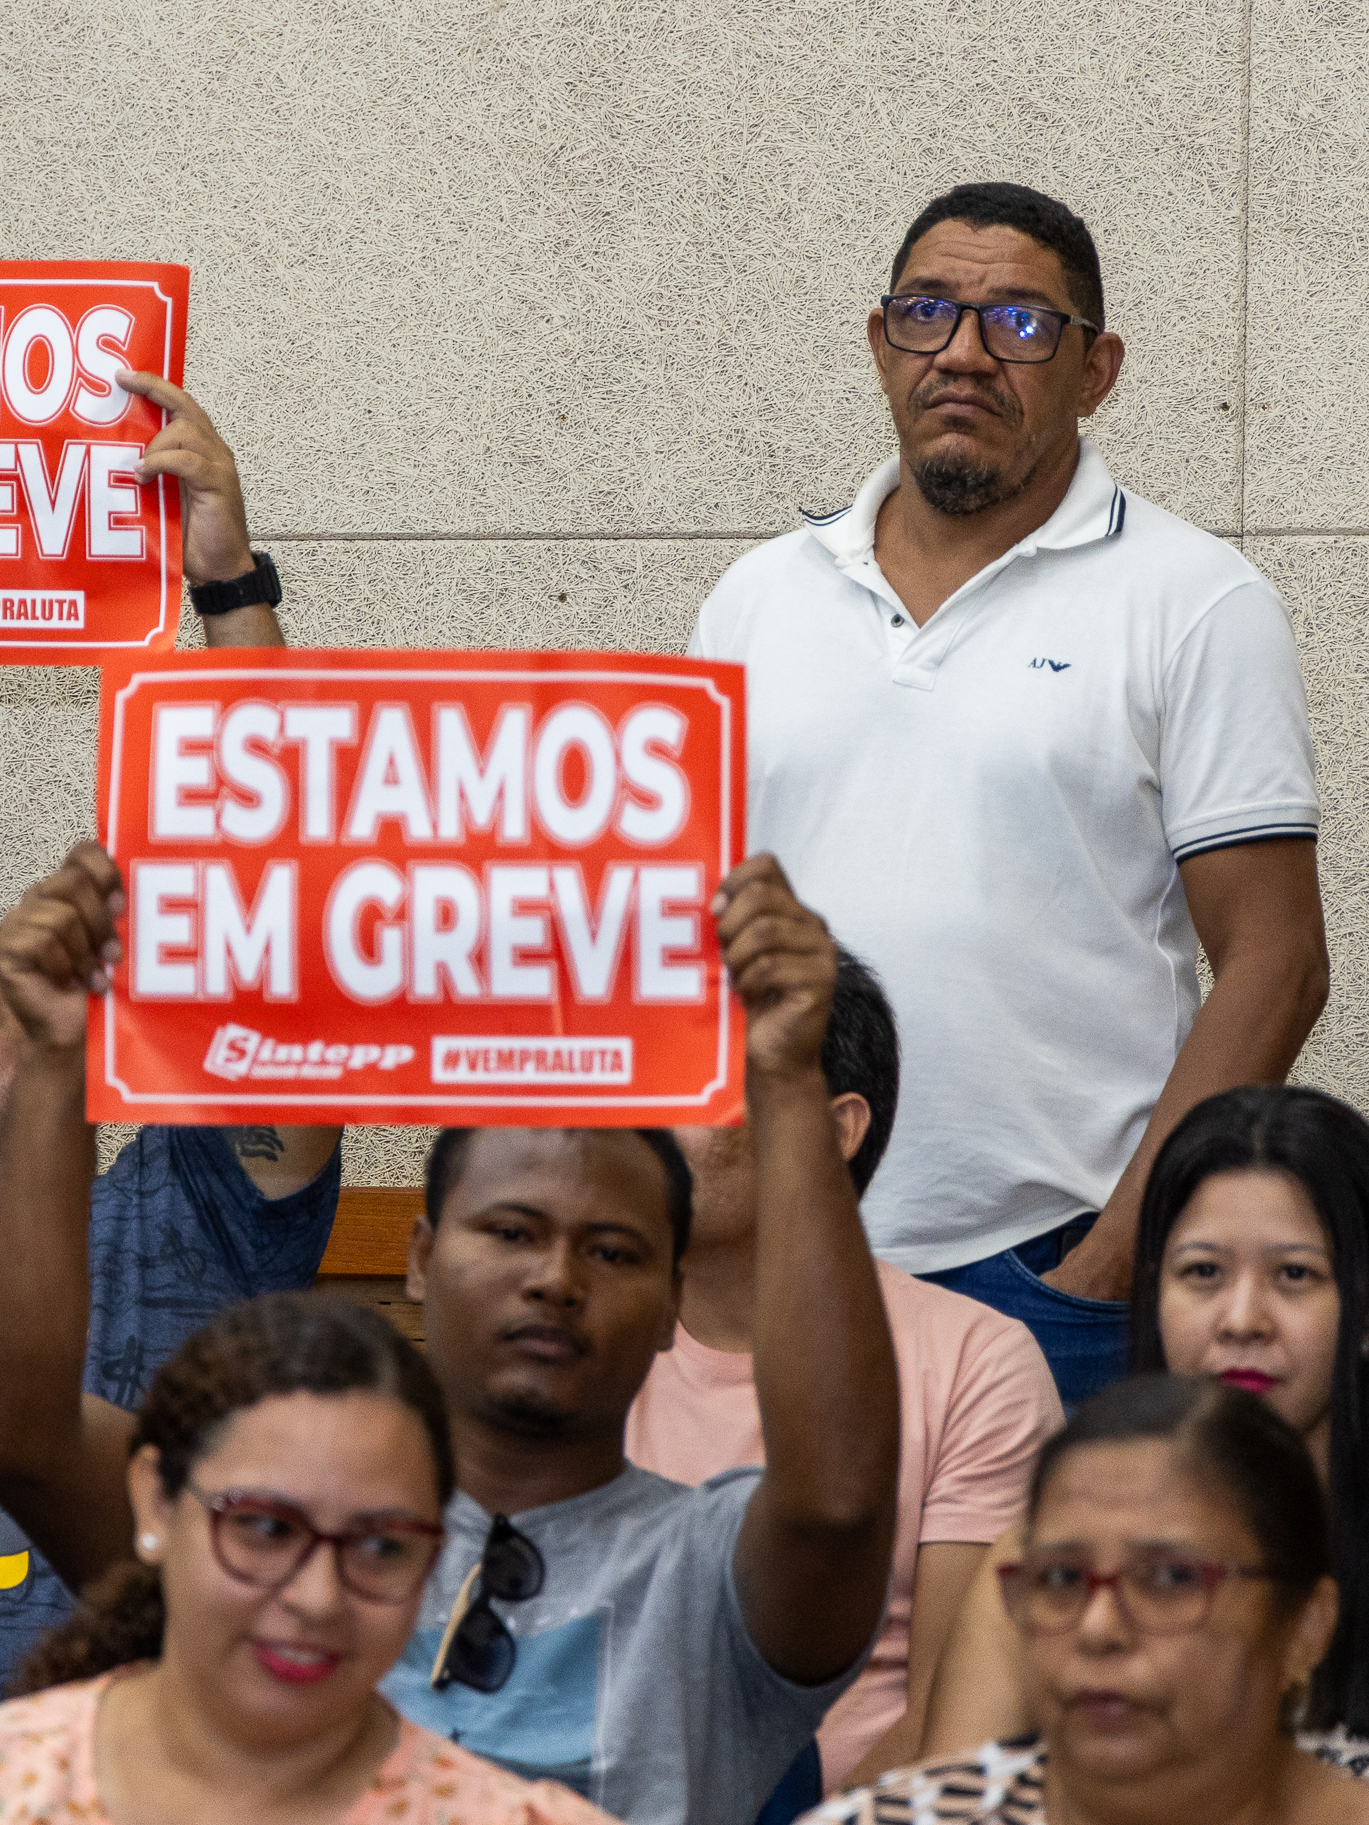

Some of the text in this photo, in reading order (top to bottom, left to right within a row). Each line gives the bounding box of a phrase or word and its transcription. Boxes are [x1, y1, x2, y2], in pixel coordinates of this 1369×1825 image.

[147, 699, 692, 849] ESTAMOS
[129, 858, 707, 1004] EM GREVE
[223, 1036, 416, 1071] Sintepp
[442, 1048, 625, 1074] #VEMPRALUTA
